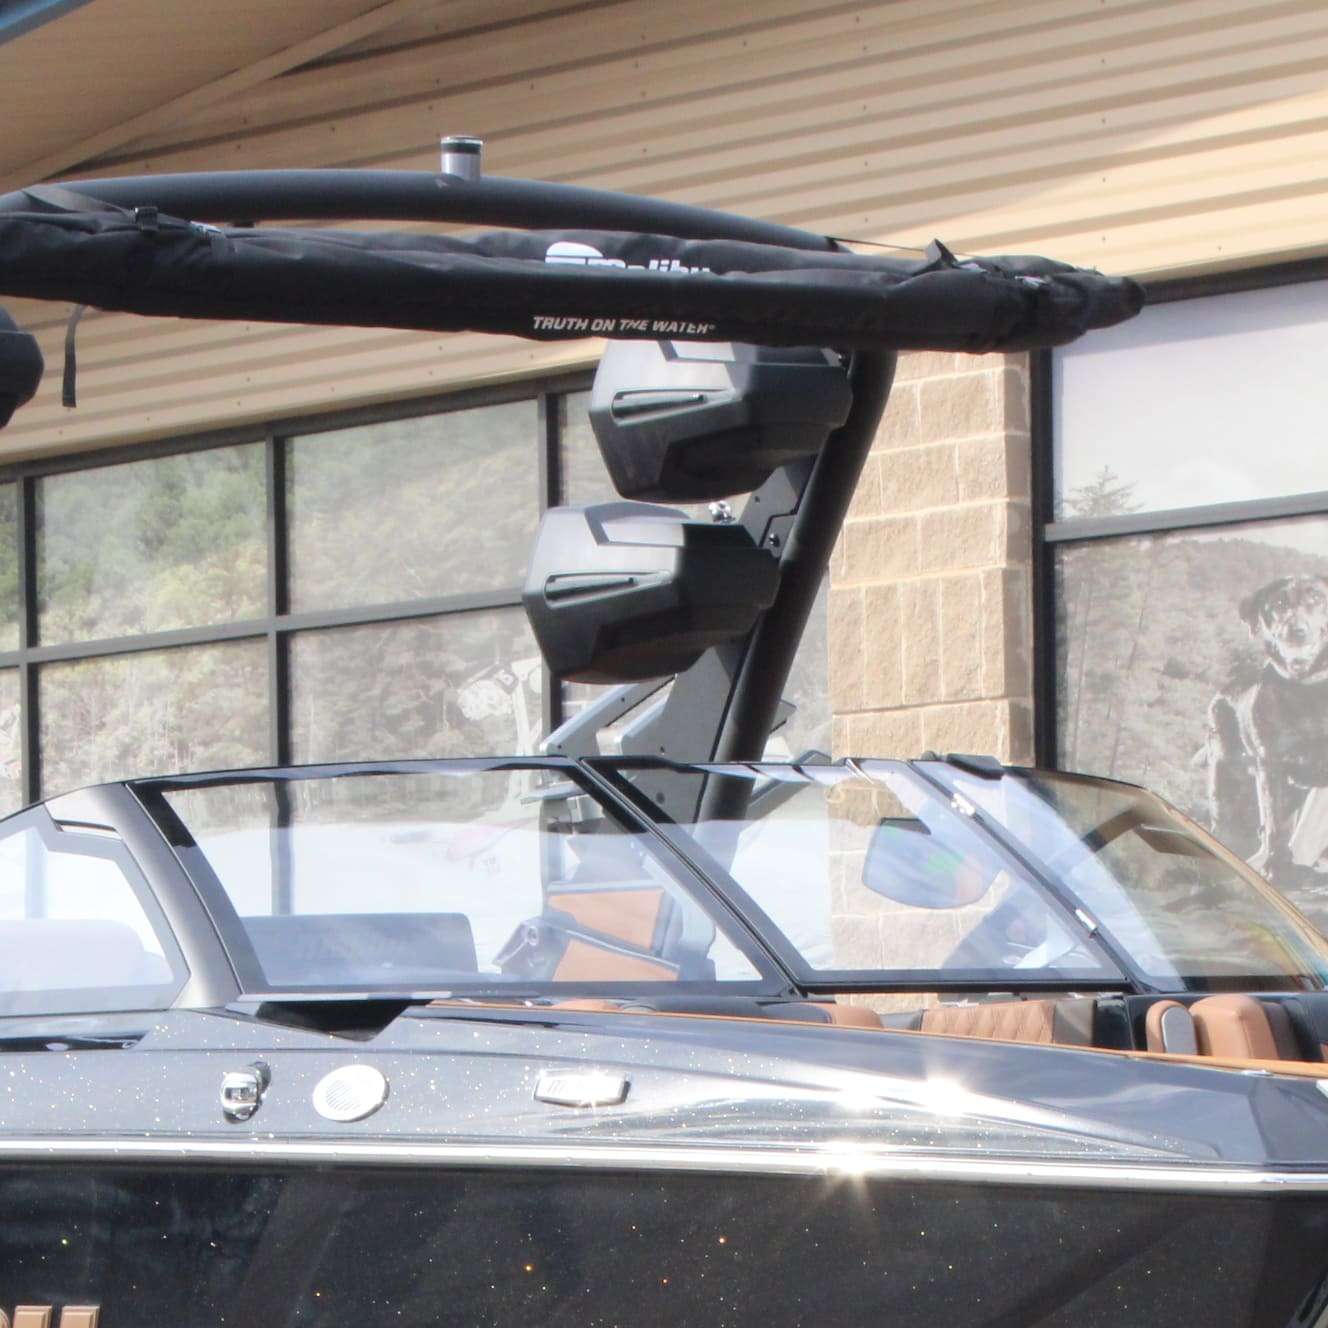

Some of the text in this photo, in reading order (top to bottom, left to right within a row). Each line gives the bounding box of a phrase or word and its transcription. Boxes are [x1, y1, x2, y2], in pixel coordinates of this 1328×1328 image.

[533, 316, 588, 330] TRUTH
[590, 318, 616, 331] ON
[619, 319, 648, 331] THE
